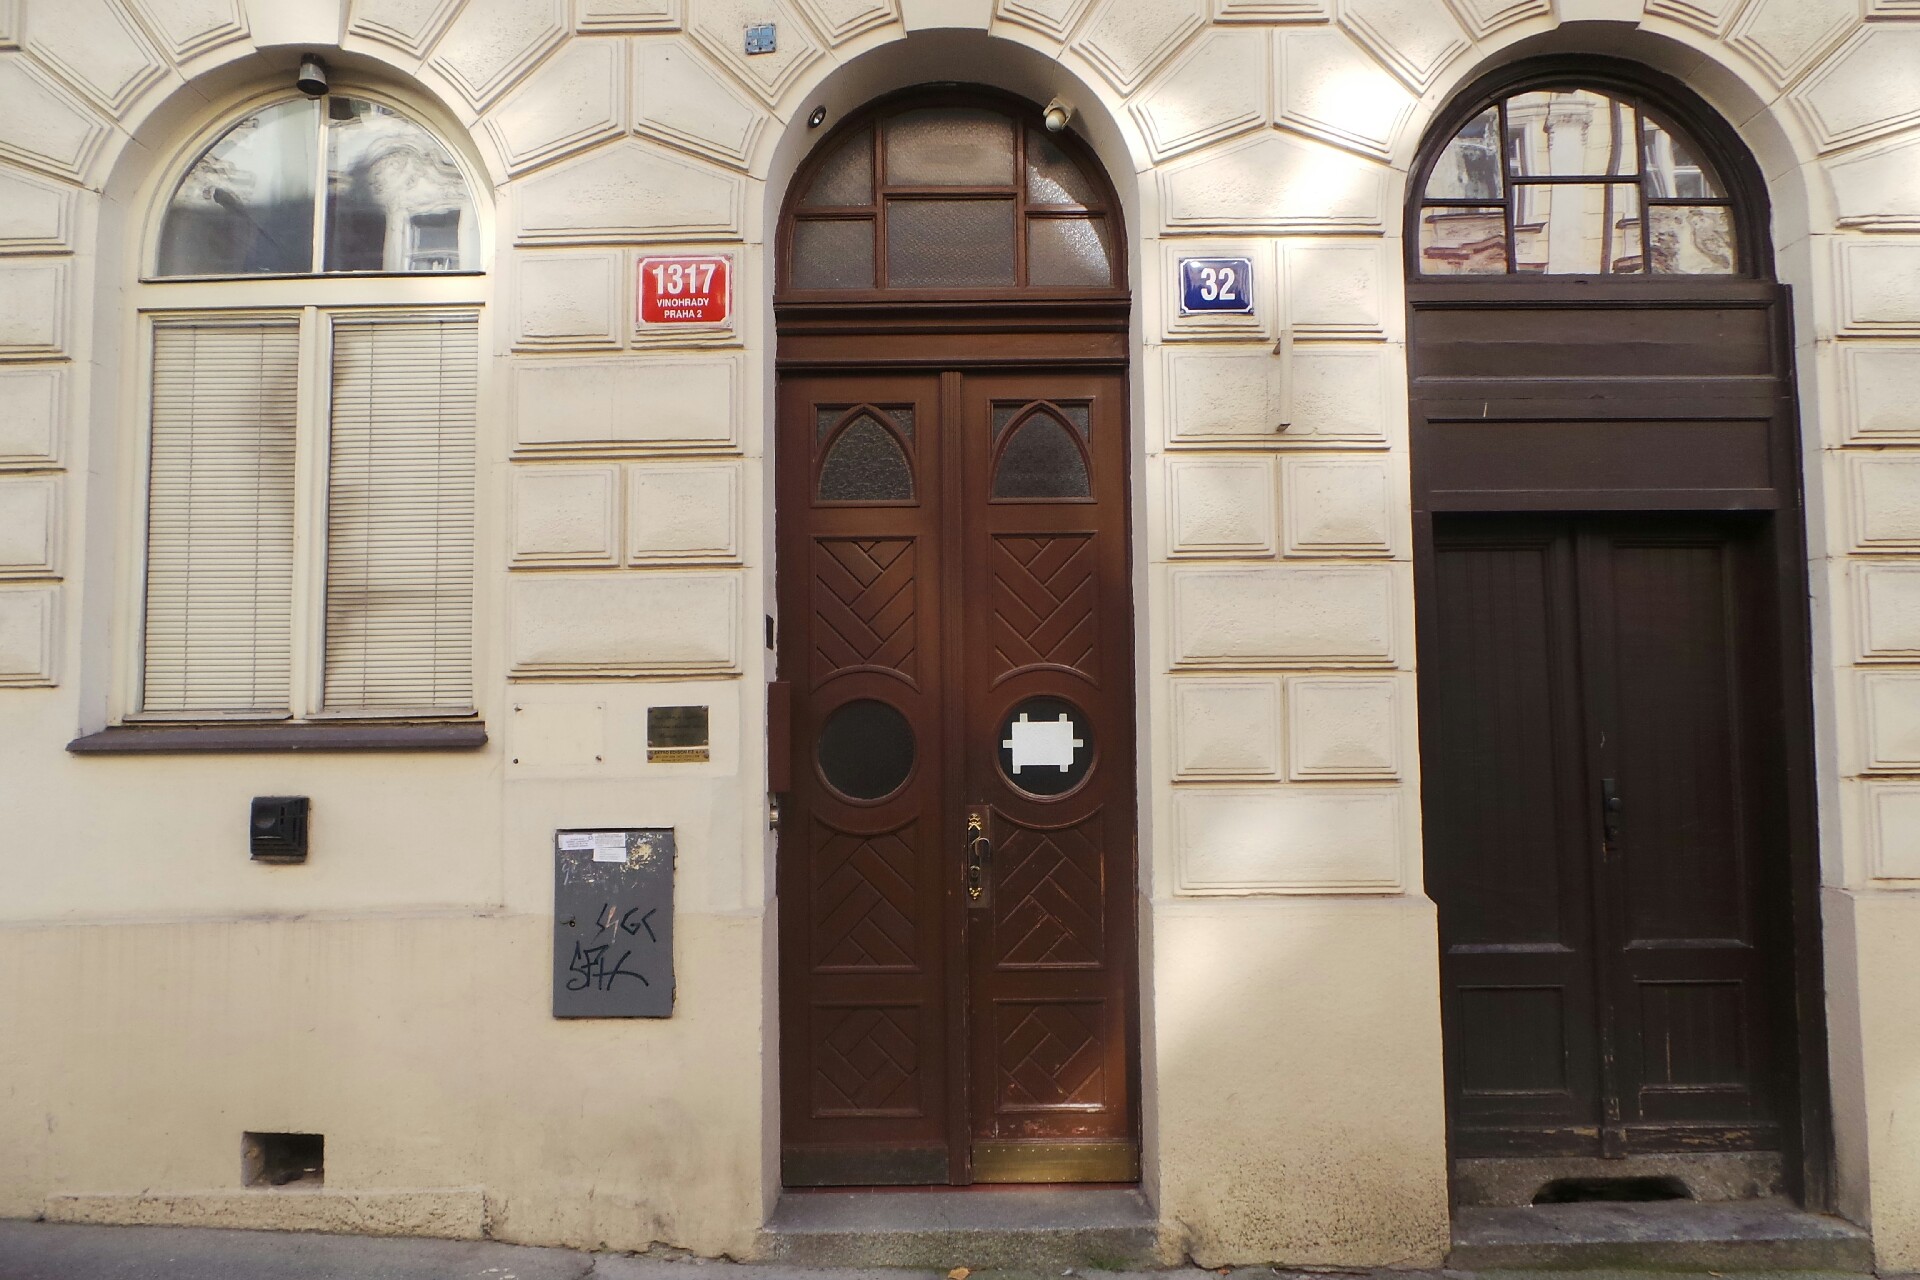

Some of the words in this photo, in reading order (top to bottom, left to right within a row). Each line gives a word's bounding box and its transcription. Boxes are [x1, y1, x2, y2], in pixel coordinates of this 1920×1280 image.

[652, 263, 716, 295] 1317
[1200, 267, 1236, 301] 32
[656, 298, 709, 308] VINOHRADY
[664, 310, 695, 319] PRAHA
[696, 309, 703, 318] 2
